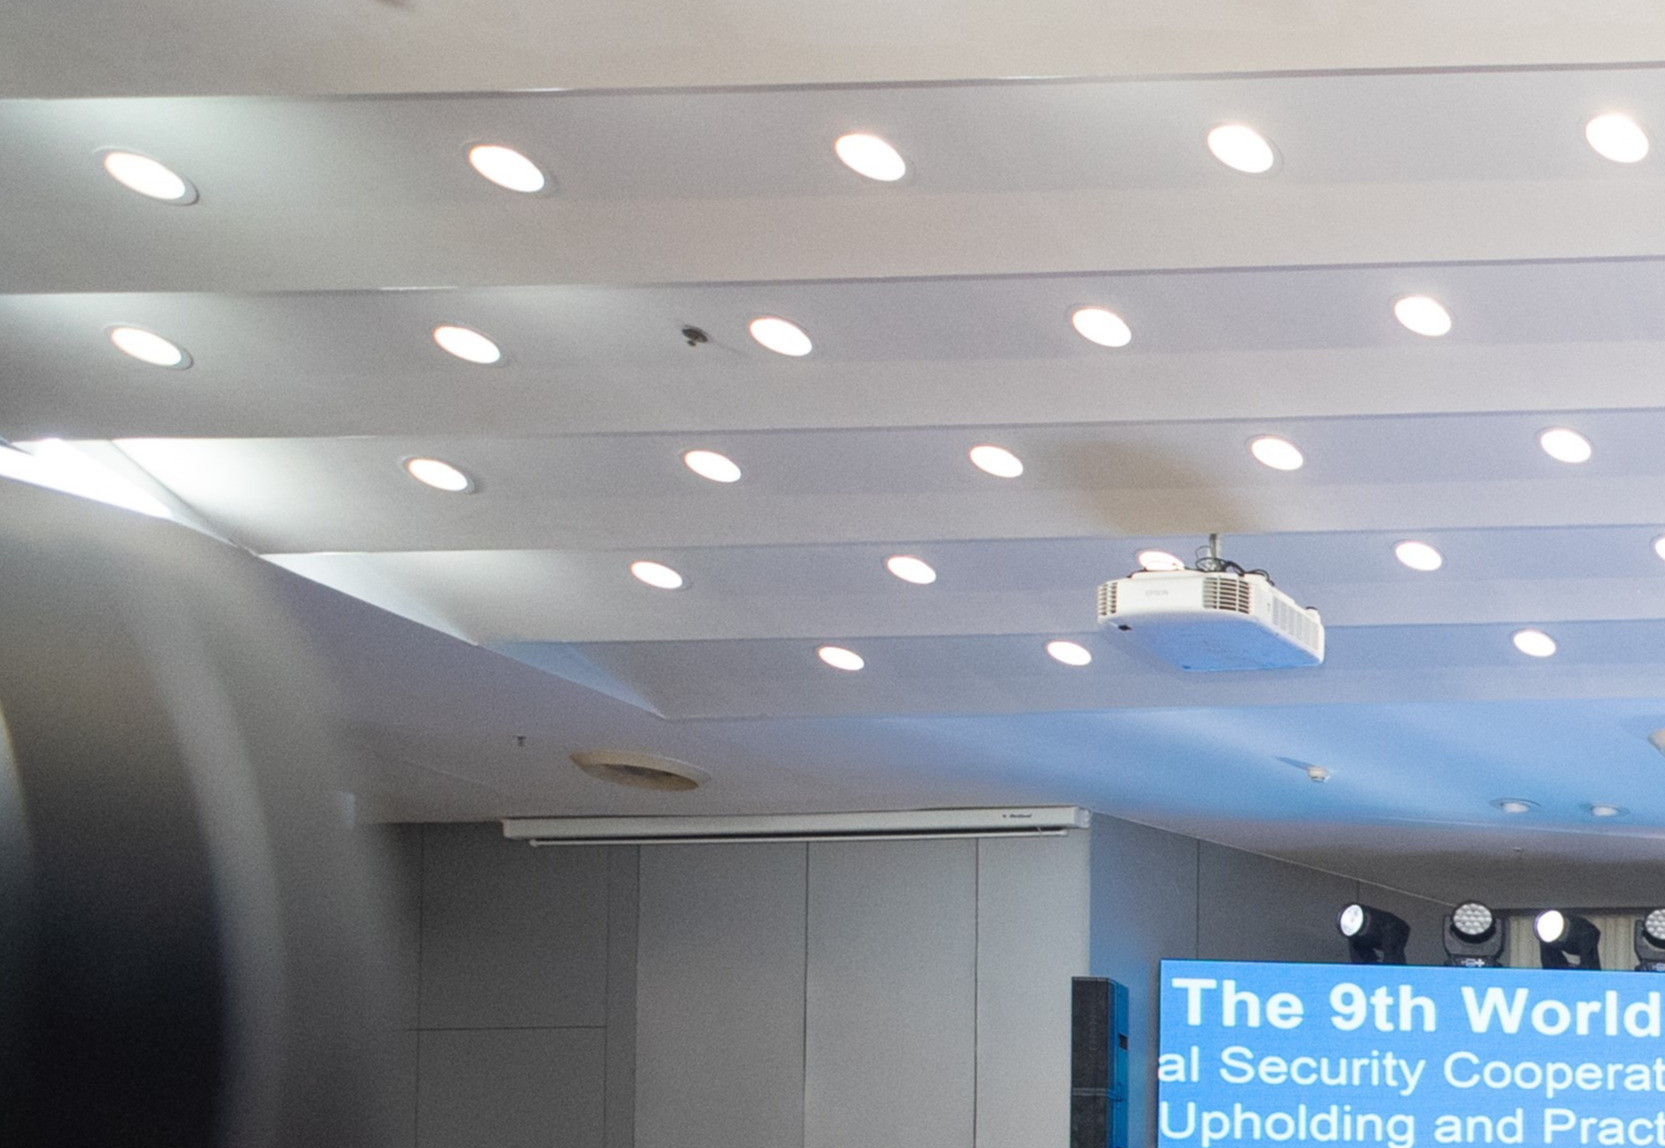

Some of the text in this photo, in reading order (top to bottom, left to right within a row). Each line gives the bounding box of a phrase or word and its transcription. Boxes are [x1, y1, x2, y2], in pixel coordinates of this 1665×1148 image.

[1171, 977, 1305, 1030] The
[1329, 981, 1437, 1033] 9th
[1461, 985, 1661, 1038] World
[1219, 1045, 1427, 1097] Security
[1433, 1107, 1524, 1145] and
